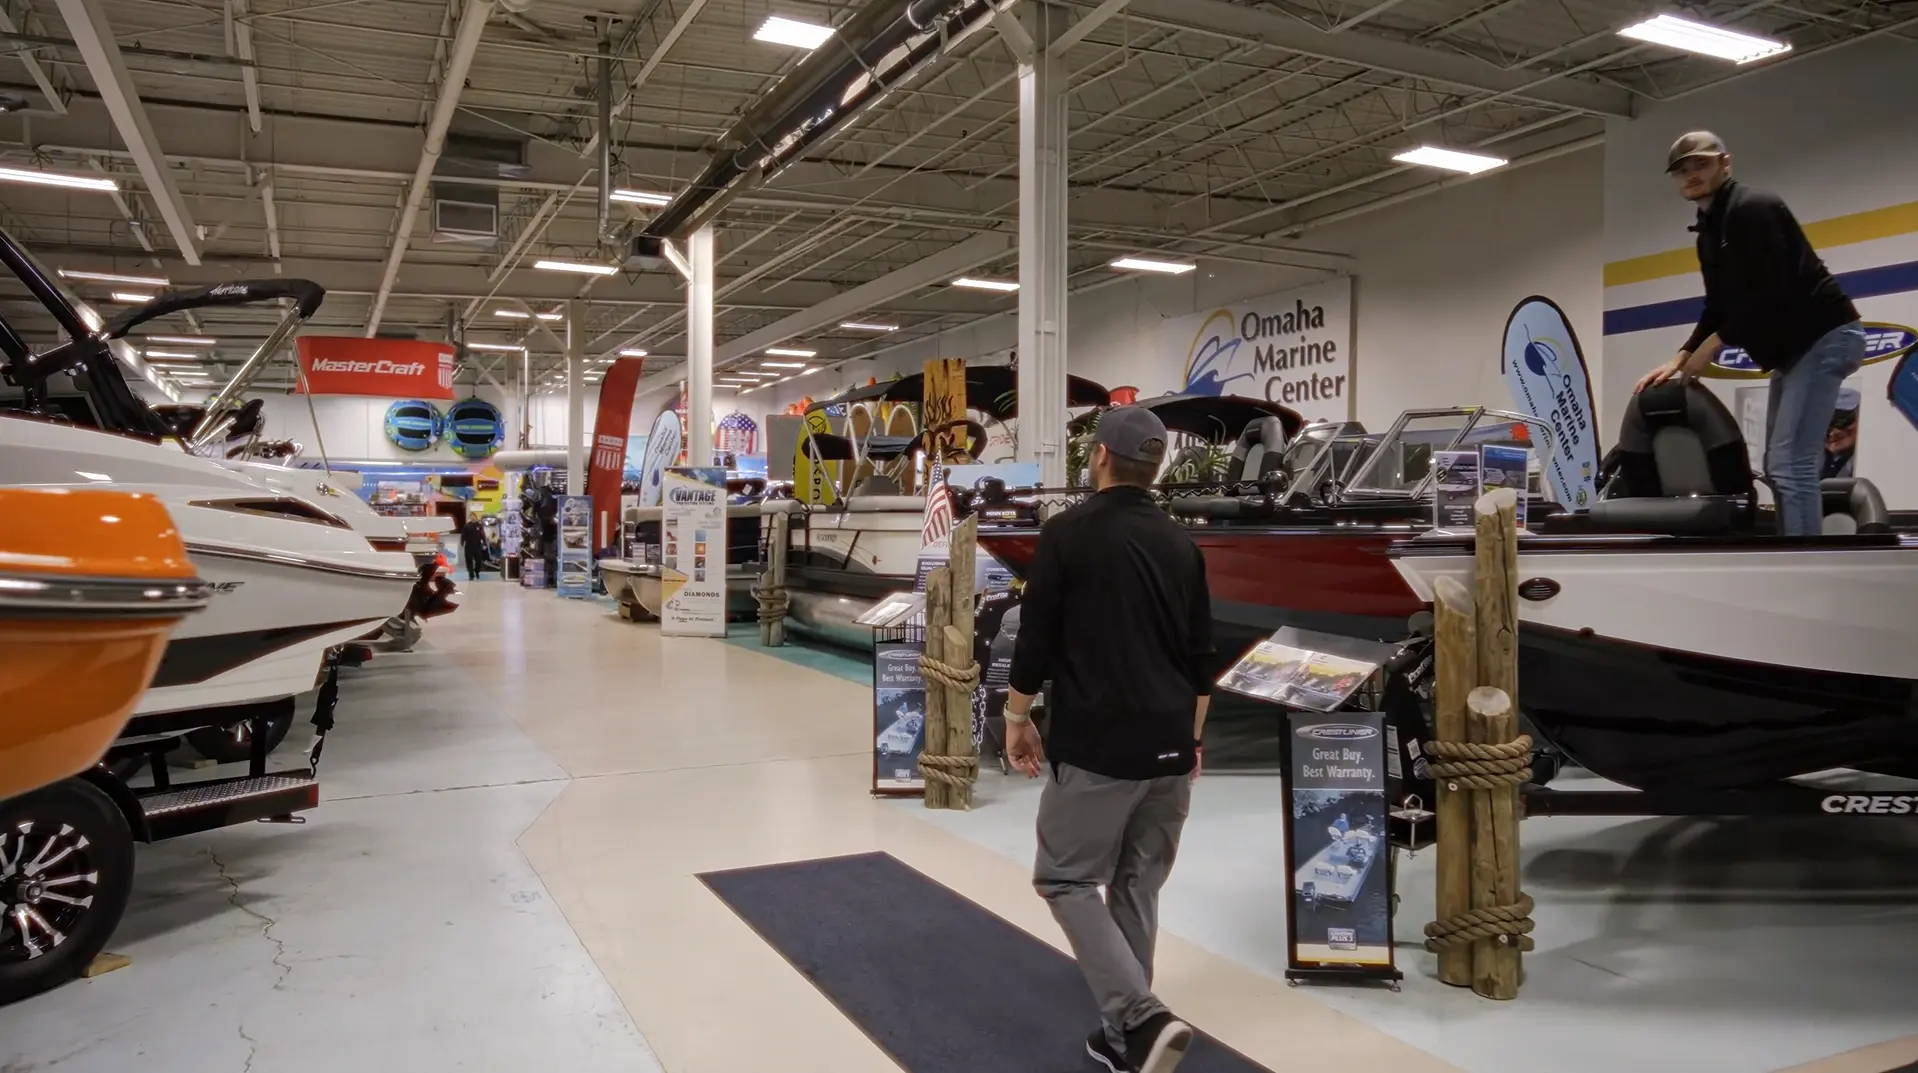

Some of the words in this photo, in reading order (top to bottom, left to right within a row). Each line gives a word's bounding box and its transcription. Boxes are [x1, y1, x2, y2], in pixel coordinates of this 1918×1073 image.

[1241, 299, 1324, 342] Omaha
[312, 358, 425, 376] MasterCraft
[1253, 335, 1337, 375] Marine
[1265, 372, 1346, 404] Center
[1562, 374, 1587, 430] Omaha
[1550, 409, 1574, 461] Center
[1556, 390, 1580, 445] Marine
[675, 490, 716, 502] VANTAGE
[1302, 764, 1324, 778] Best
[1326, 764, 1377, 782] Warranty.
[1312, 747, 1340, 760] Great
[1342, 747, 1364, 764] Buy.
